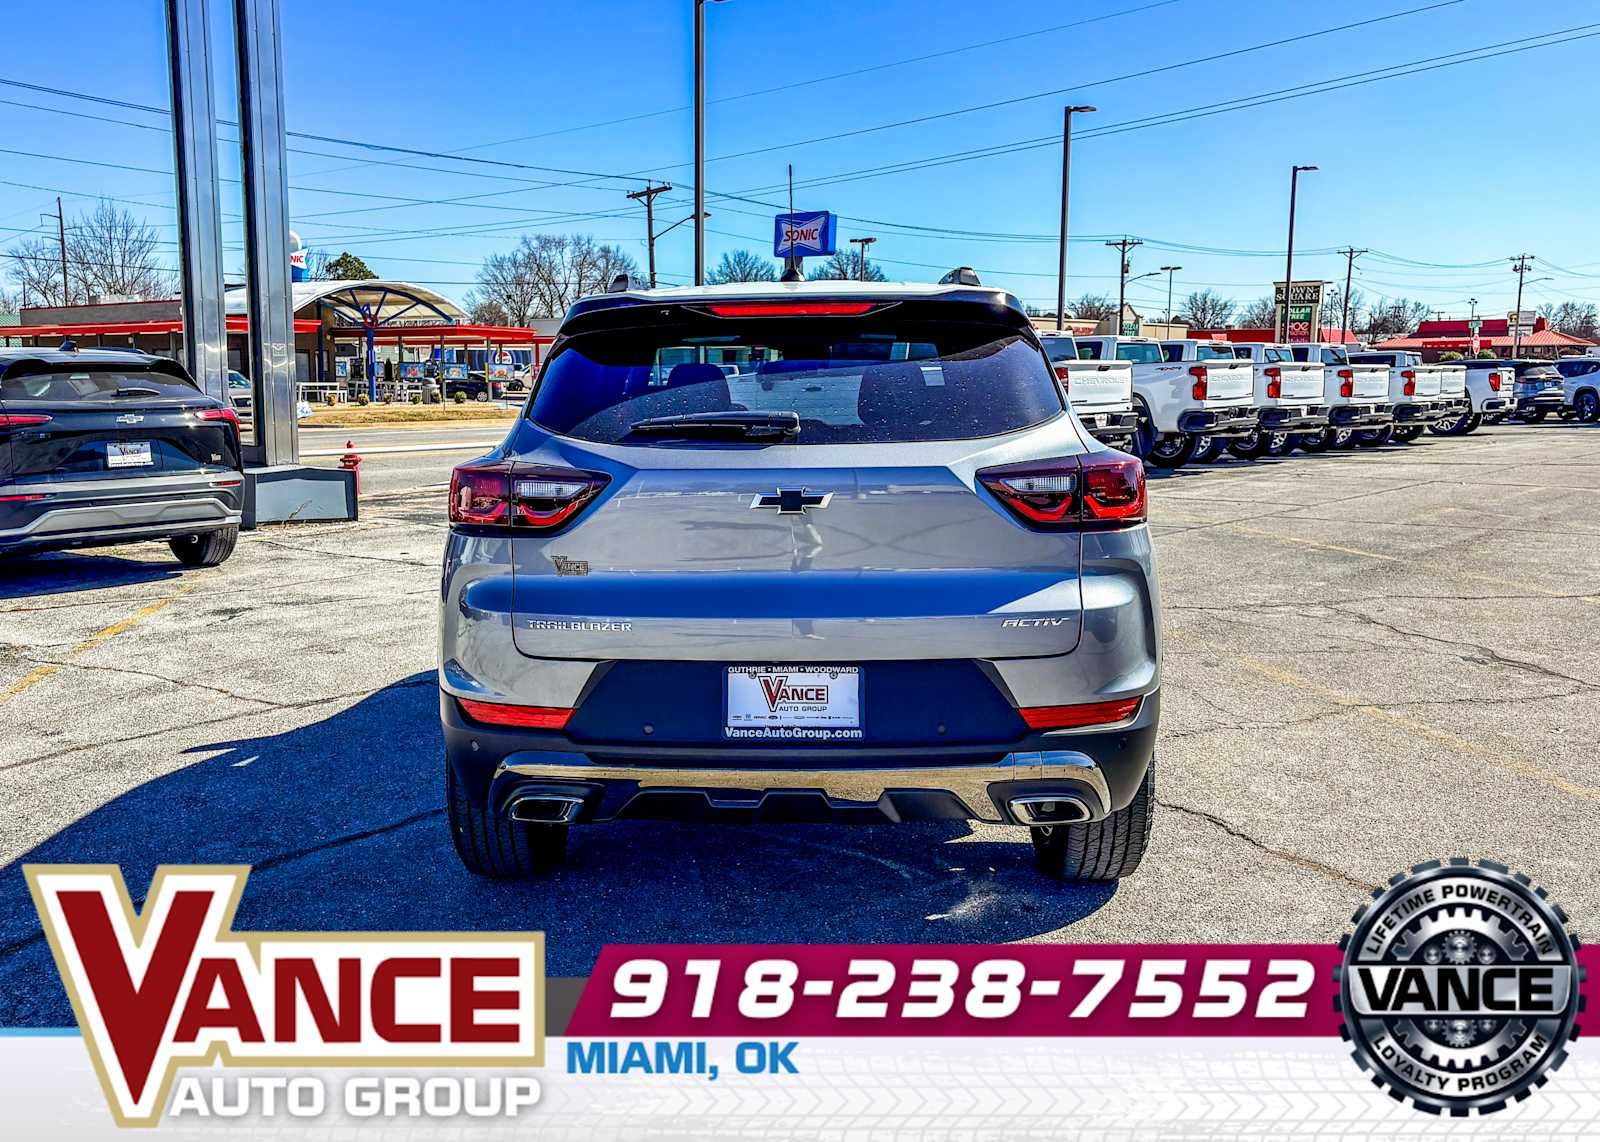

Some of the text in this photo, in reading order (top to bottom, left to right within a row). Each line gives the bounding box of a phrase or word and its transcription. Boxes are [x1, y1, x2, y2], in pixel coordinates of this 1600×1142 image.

[783, 228, 819, 242] SONIC
[290, 255, 305, 263] NIC
[528, 620, 633, 631] TRAILBLAZER
[1002, 617, 1070, 628] ACTIV
[760, 677, 827, 710] VANCE
[725, 727, 862, 740] VanceAutoGroup.com
